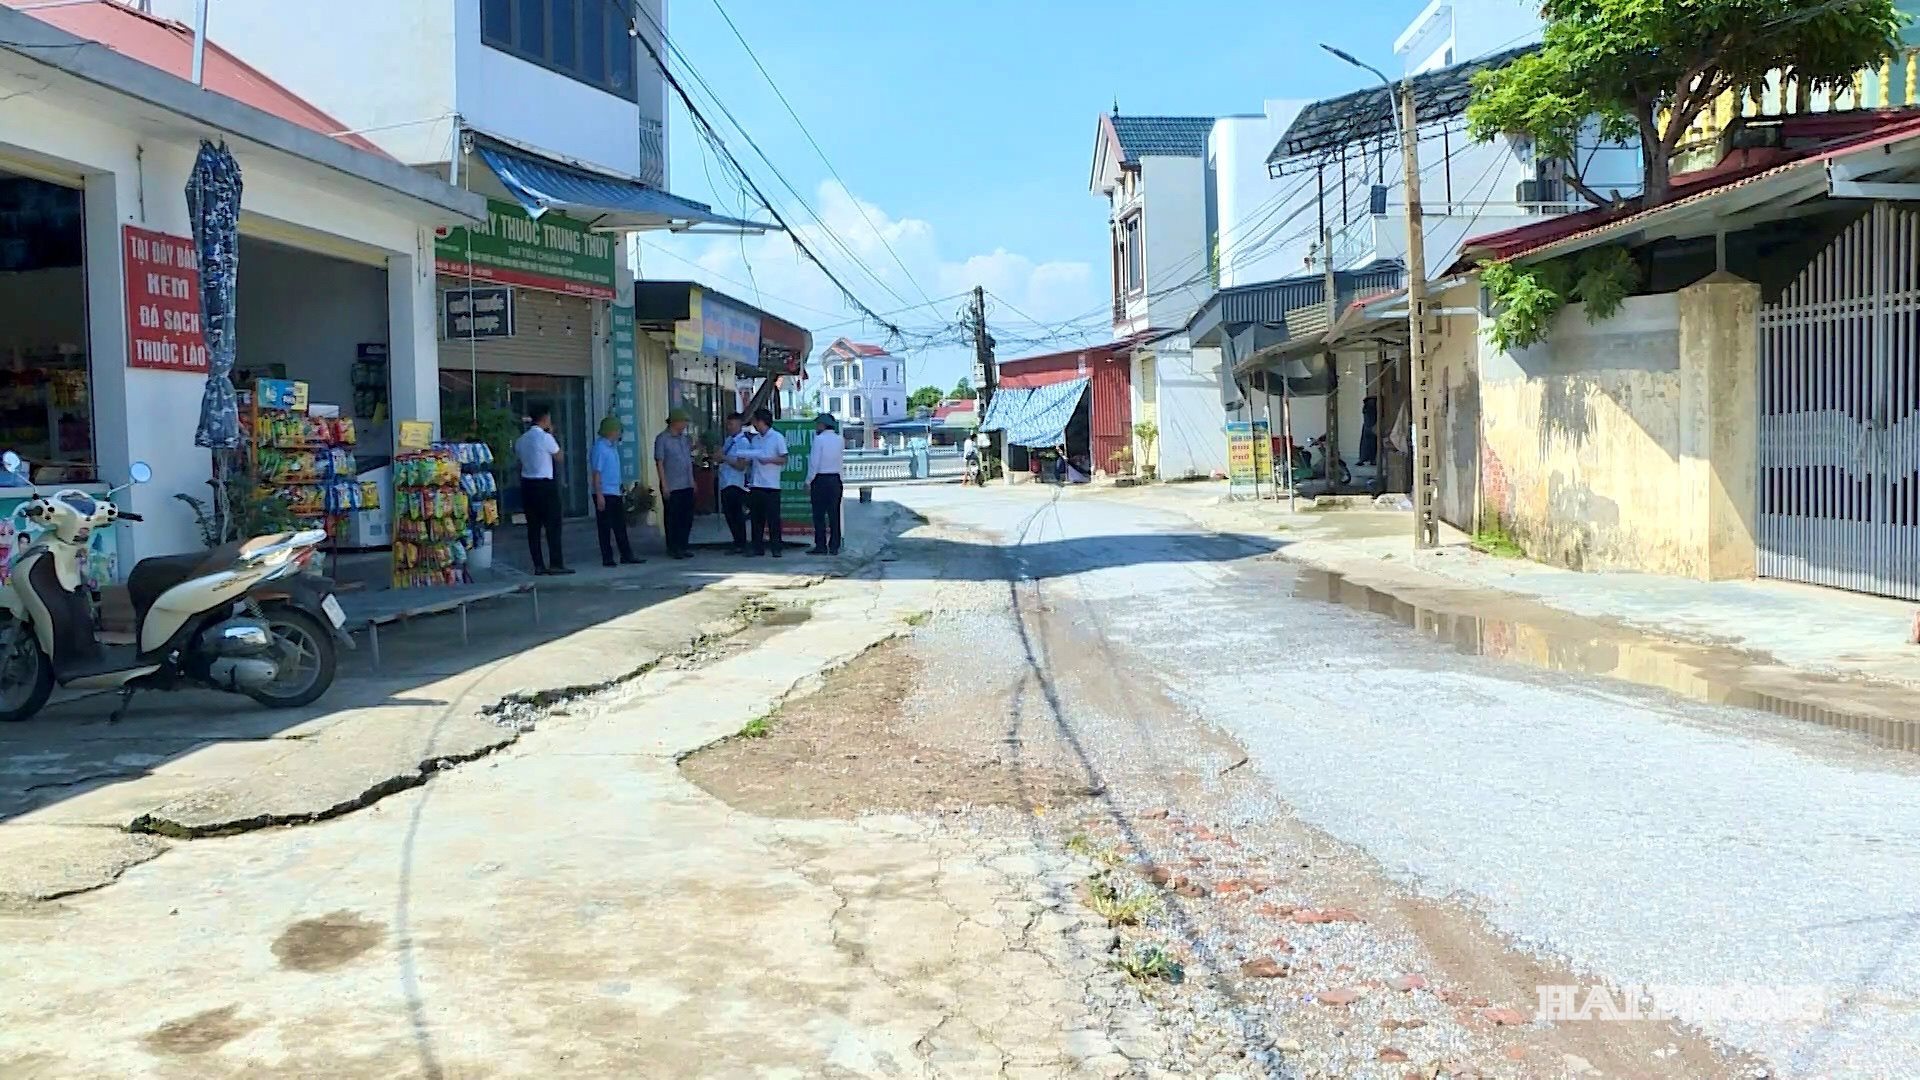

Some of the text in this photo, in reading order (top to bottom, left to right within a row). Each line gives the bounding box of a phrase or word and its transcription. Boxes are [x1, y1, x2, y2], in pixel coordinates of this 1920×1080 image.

[131, 236, 149, 265] TẠI
[543, 224, 581, 254] TRUNG
[147, 273, 190, 300] KEM
[140, 303, 199, 336] ĐÁ SẠCH
[136, 335, 206, 367] THUỐC LÀO
